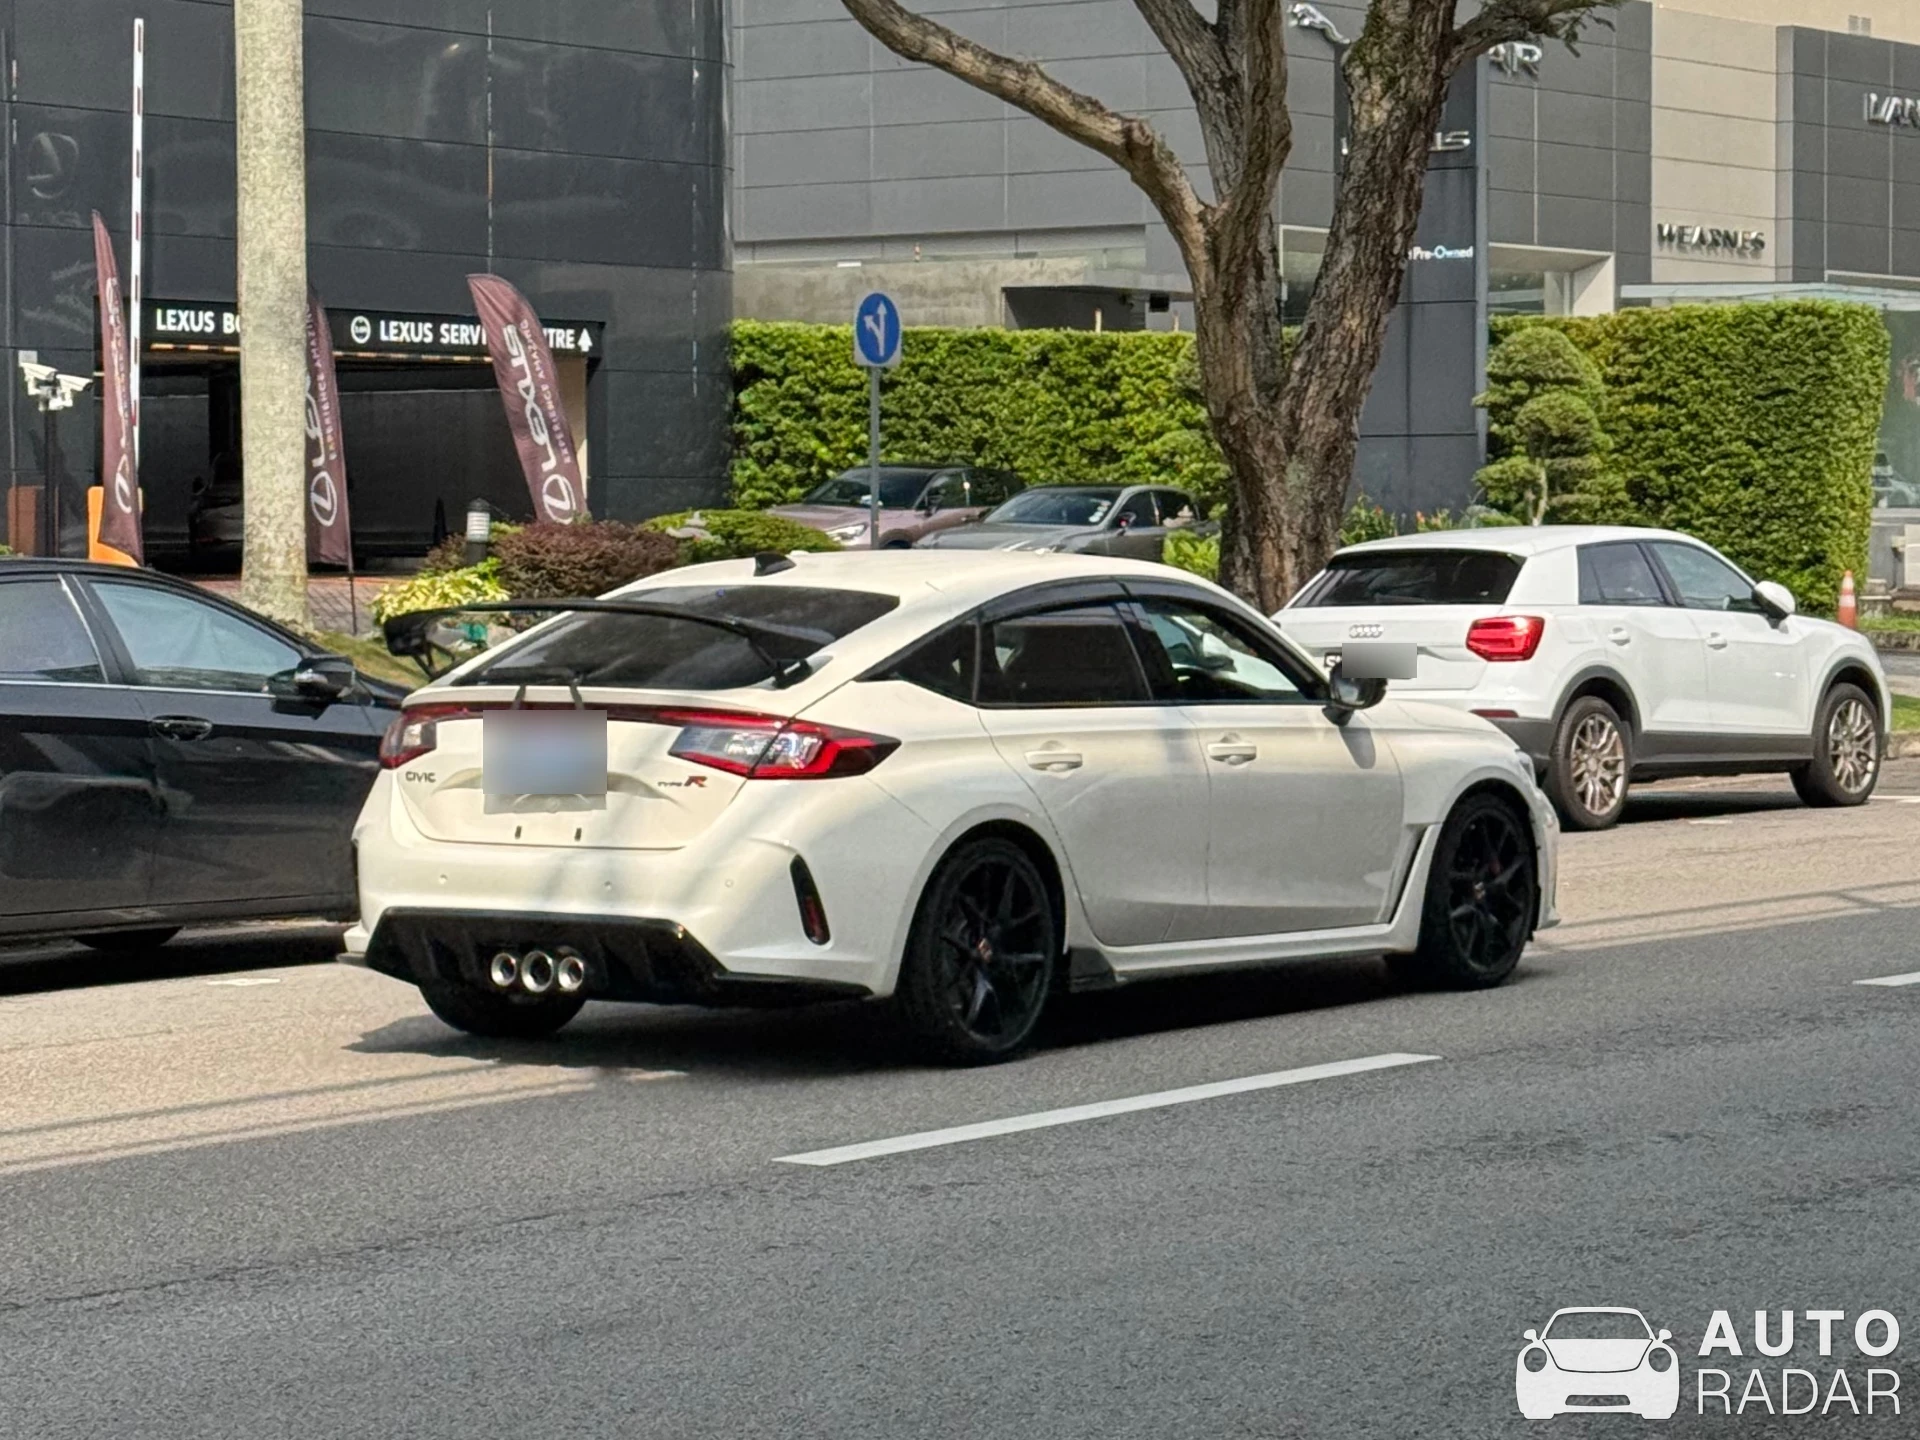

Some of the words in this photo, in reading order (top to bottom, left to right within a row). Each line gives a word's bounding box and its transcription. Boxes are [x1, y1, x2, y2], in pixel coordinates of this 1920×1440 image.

[156, 308, 215, 333] LEXUS
[379, 320, 434, 343] LEXUS
[439, 323, 488, 346] SERVI
[542, 327, 576, 349] TRE
[502, 323, 557, 472] LEXUS
[405, 771, 436, 783] CIVIC
[684, 775, 708, 787] R
